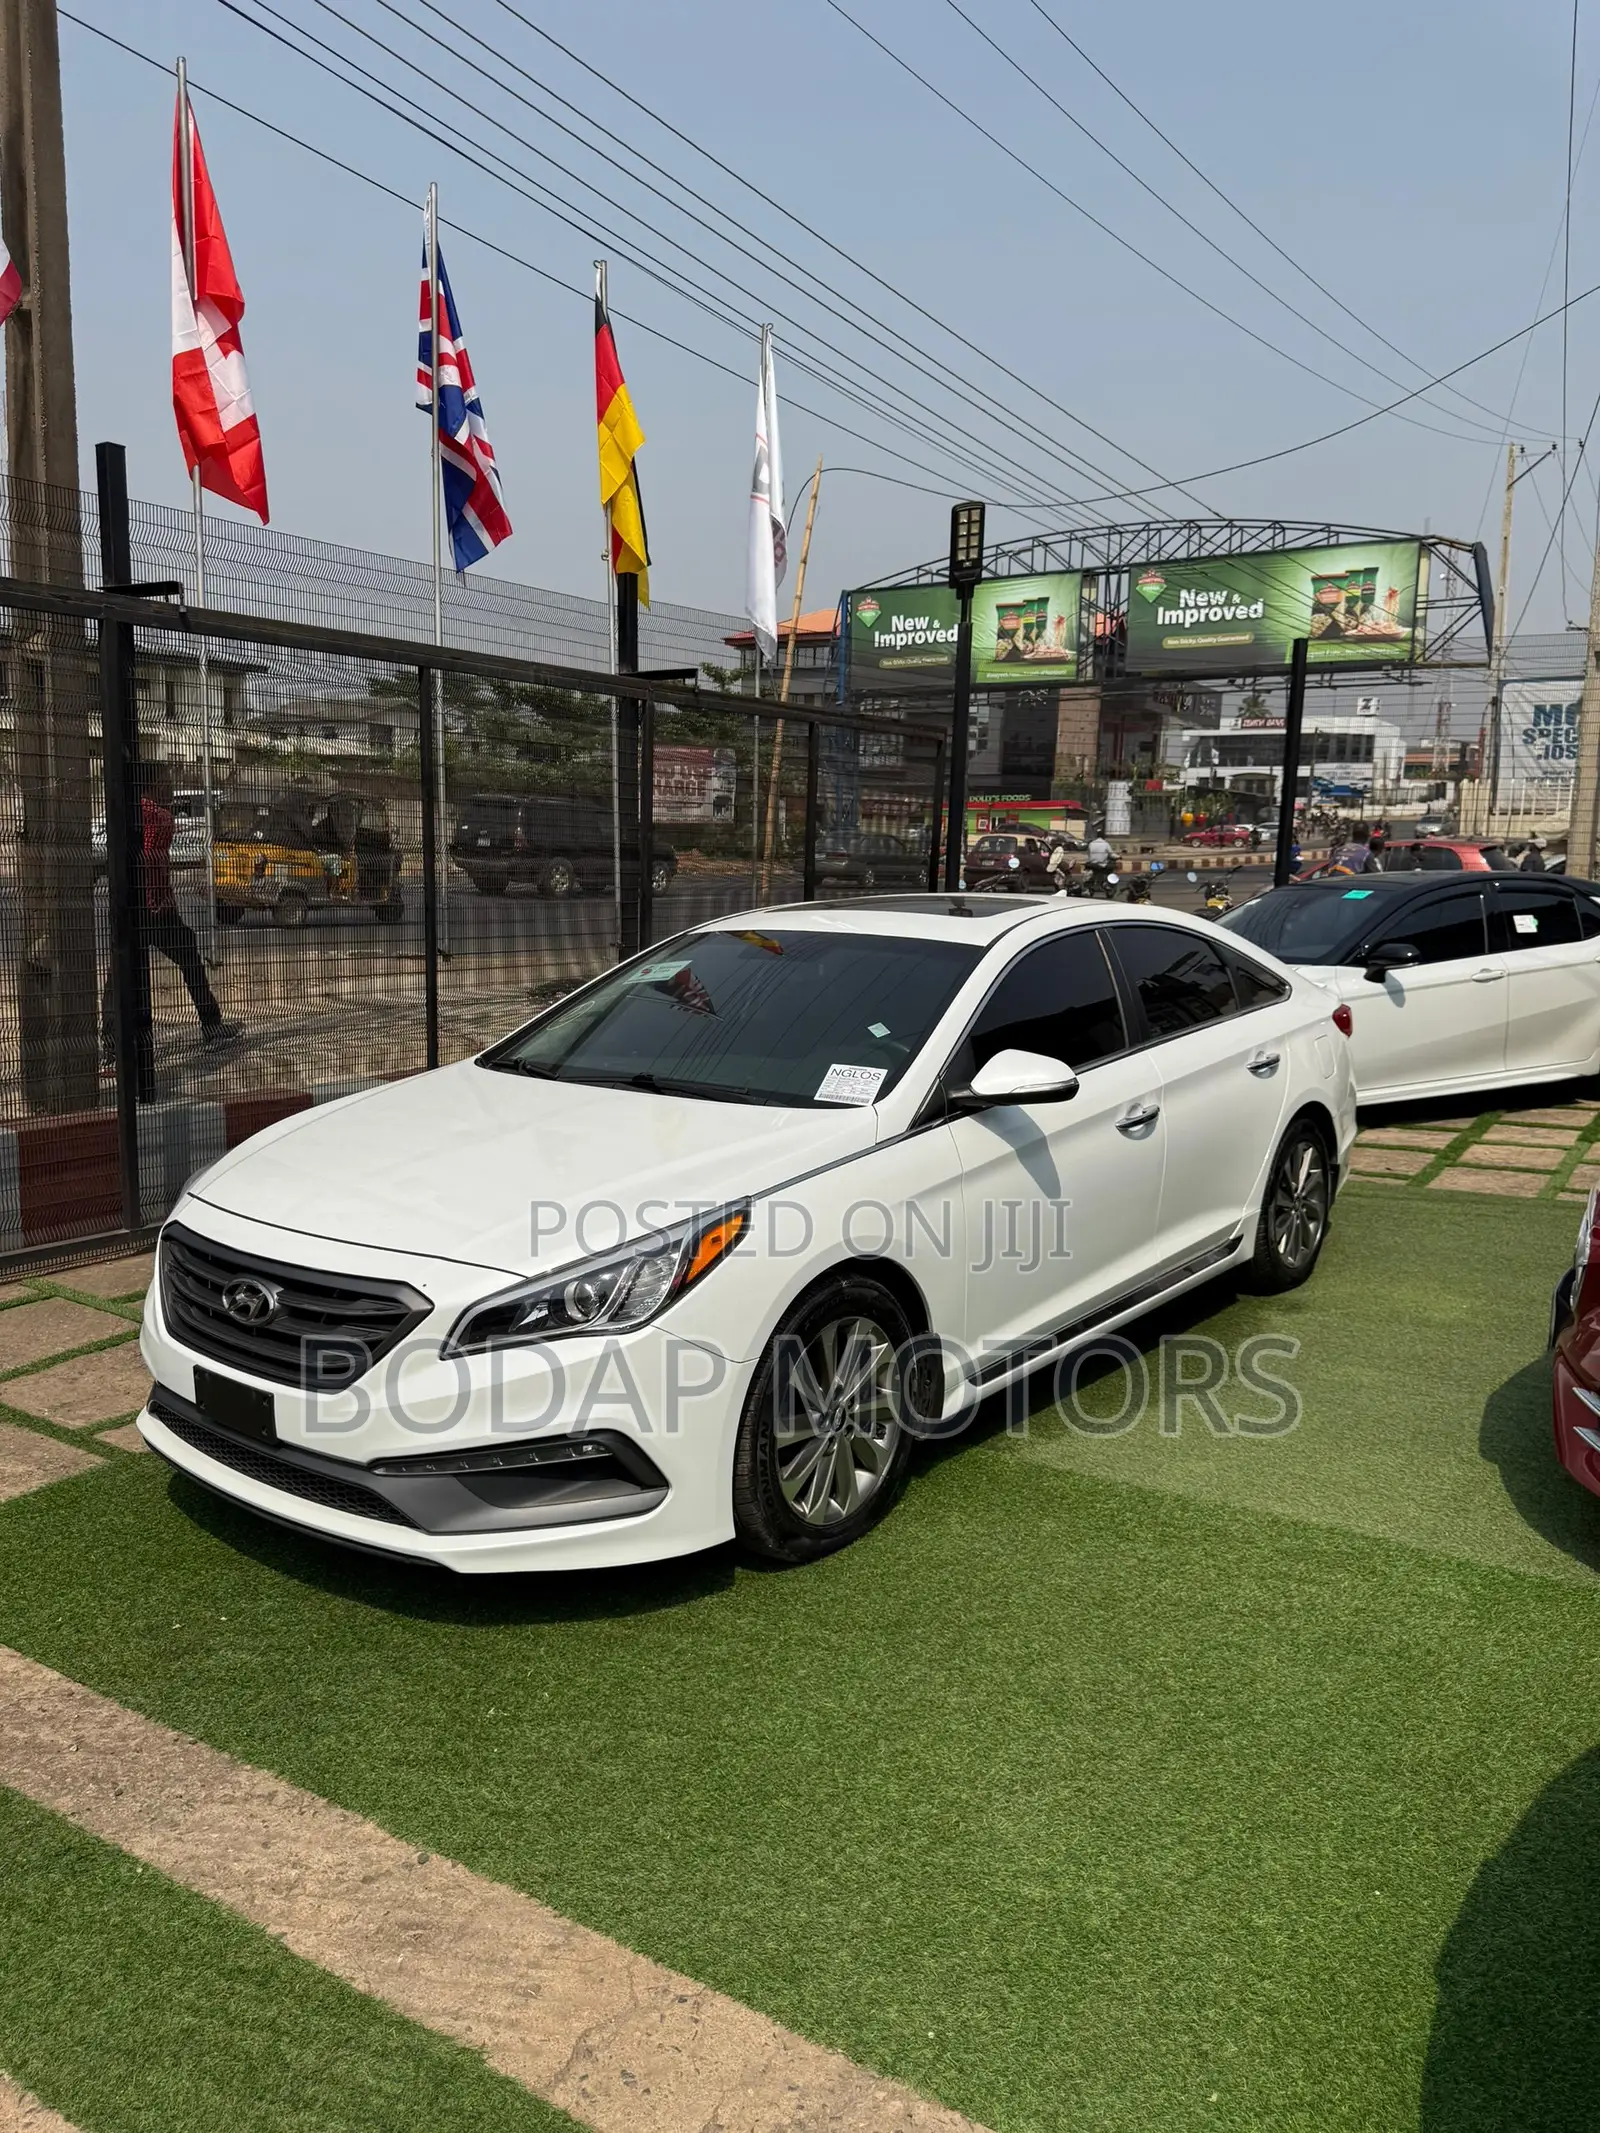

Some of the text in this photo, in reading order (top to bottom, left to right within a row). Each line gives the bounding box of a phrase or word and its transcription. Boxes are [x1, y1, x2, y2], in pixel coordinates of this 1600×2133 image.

[1179, 589, 1241, 608] New &
[1157, 598, 1264, 628] Improved
[891, 614, 941, 632] New &
[874, 624, 959, 650] Improved
[831, 1068, 882, 1081] NGLOS
